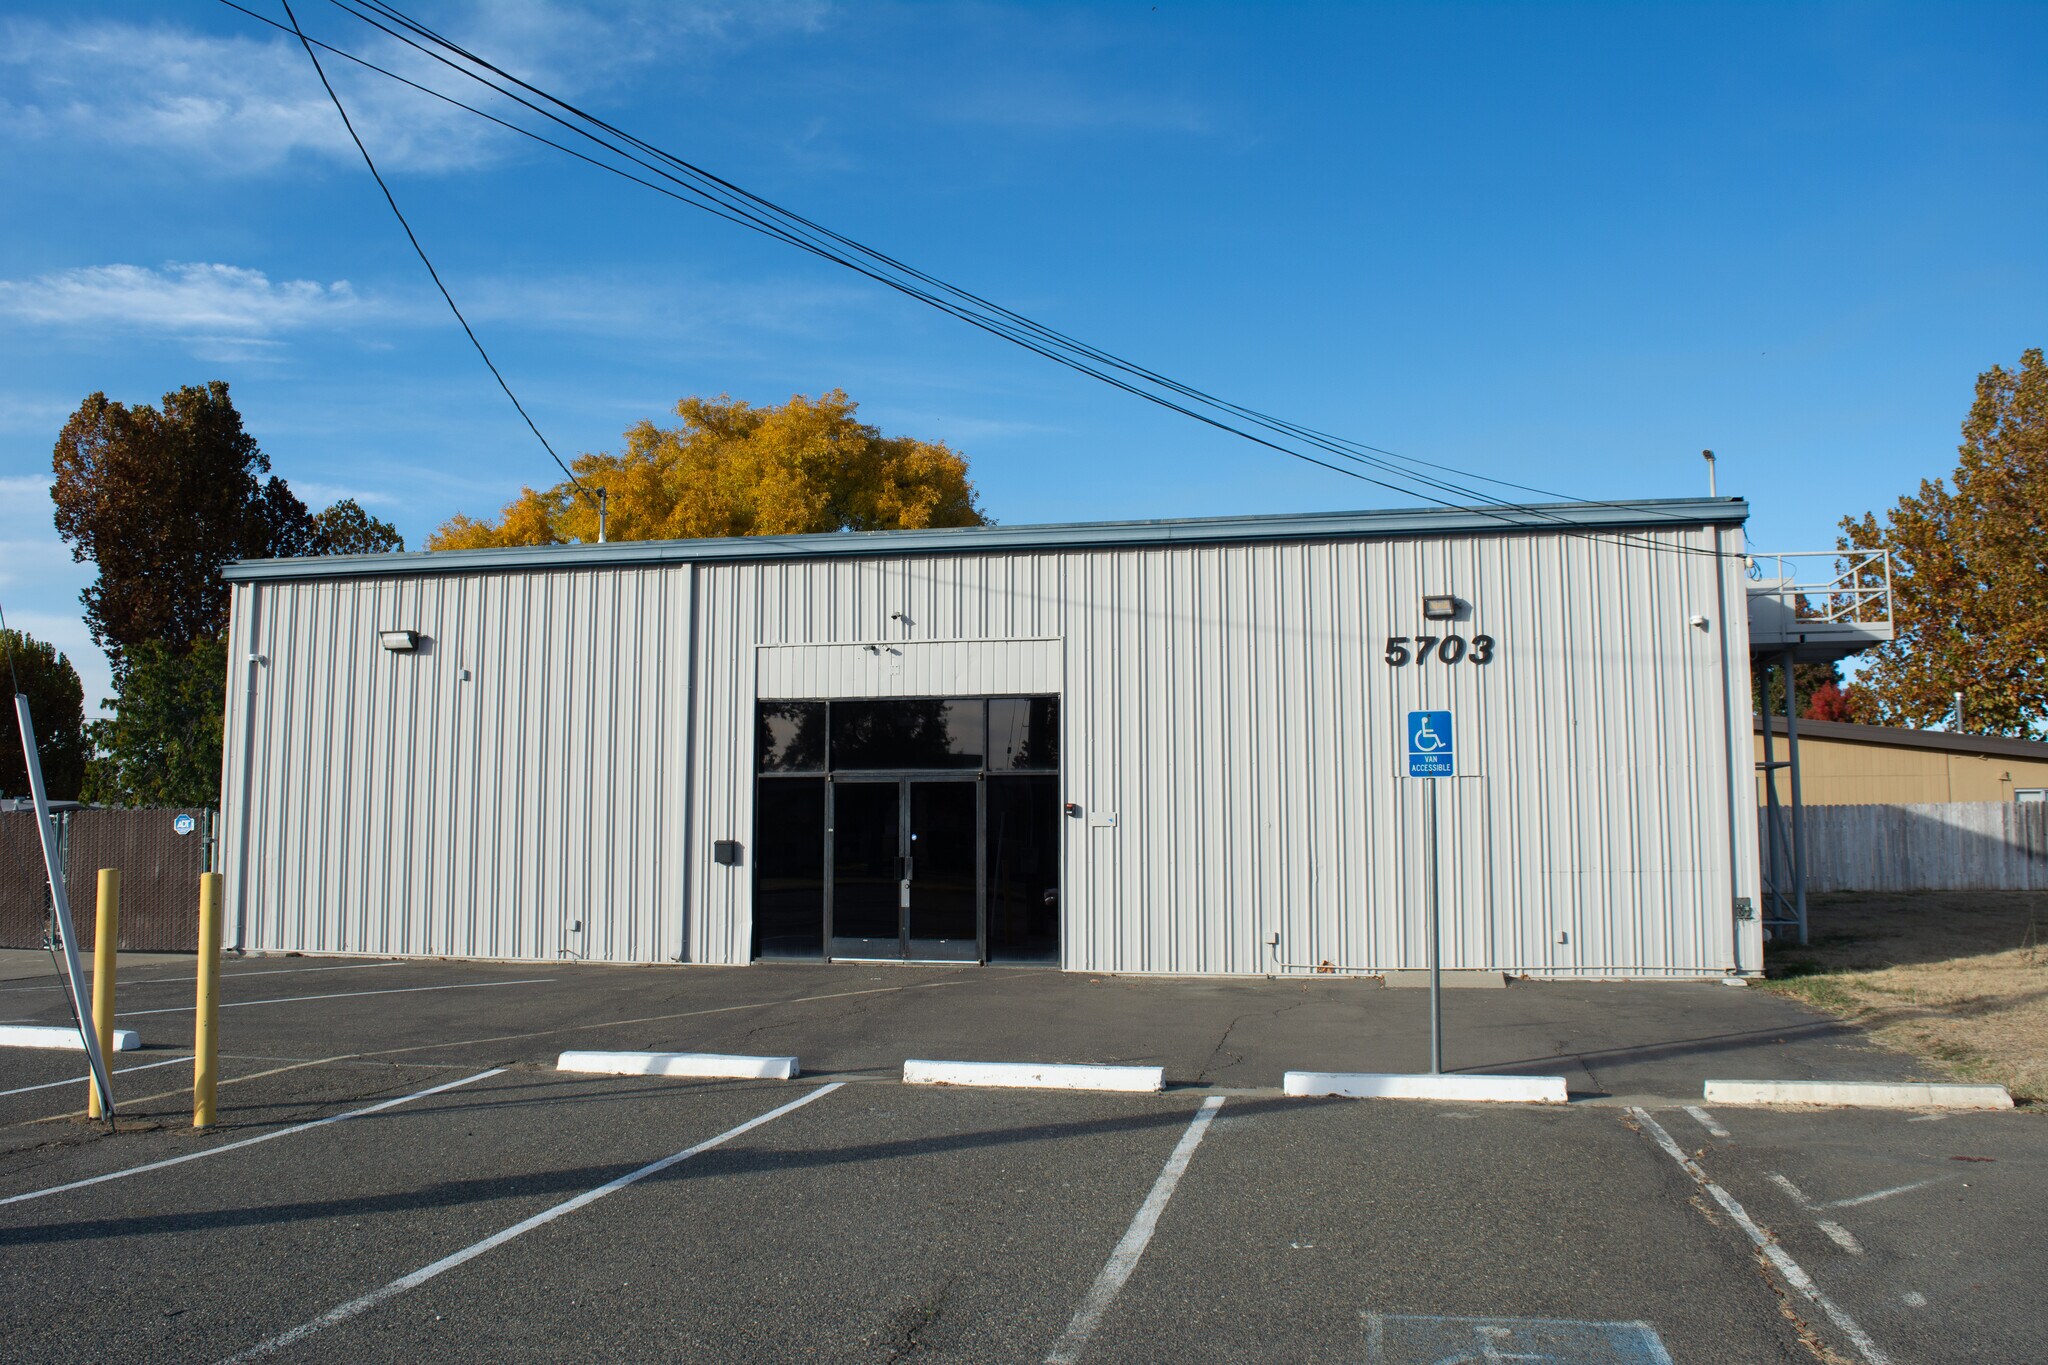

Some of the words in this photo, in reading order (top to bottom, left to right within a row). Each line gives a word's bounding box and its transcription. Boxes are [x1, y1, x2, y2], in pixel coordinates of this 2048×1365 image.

[1385, 634, 1494, 667] 5703
[1424, 755, 1438, 763] VAN
[1411, 763, 1451, 772] ACCESSIBLE
[177, 820, 191, 828] ADT
